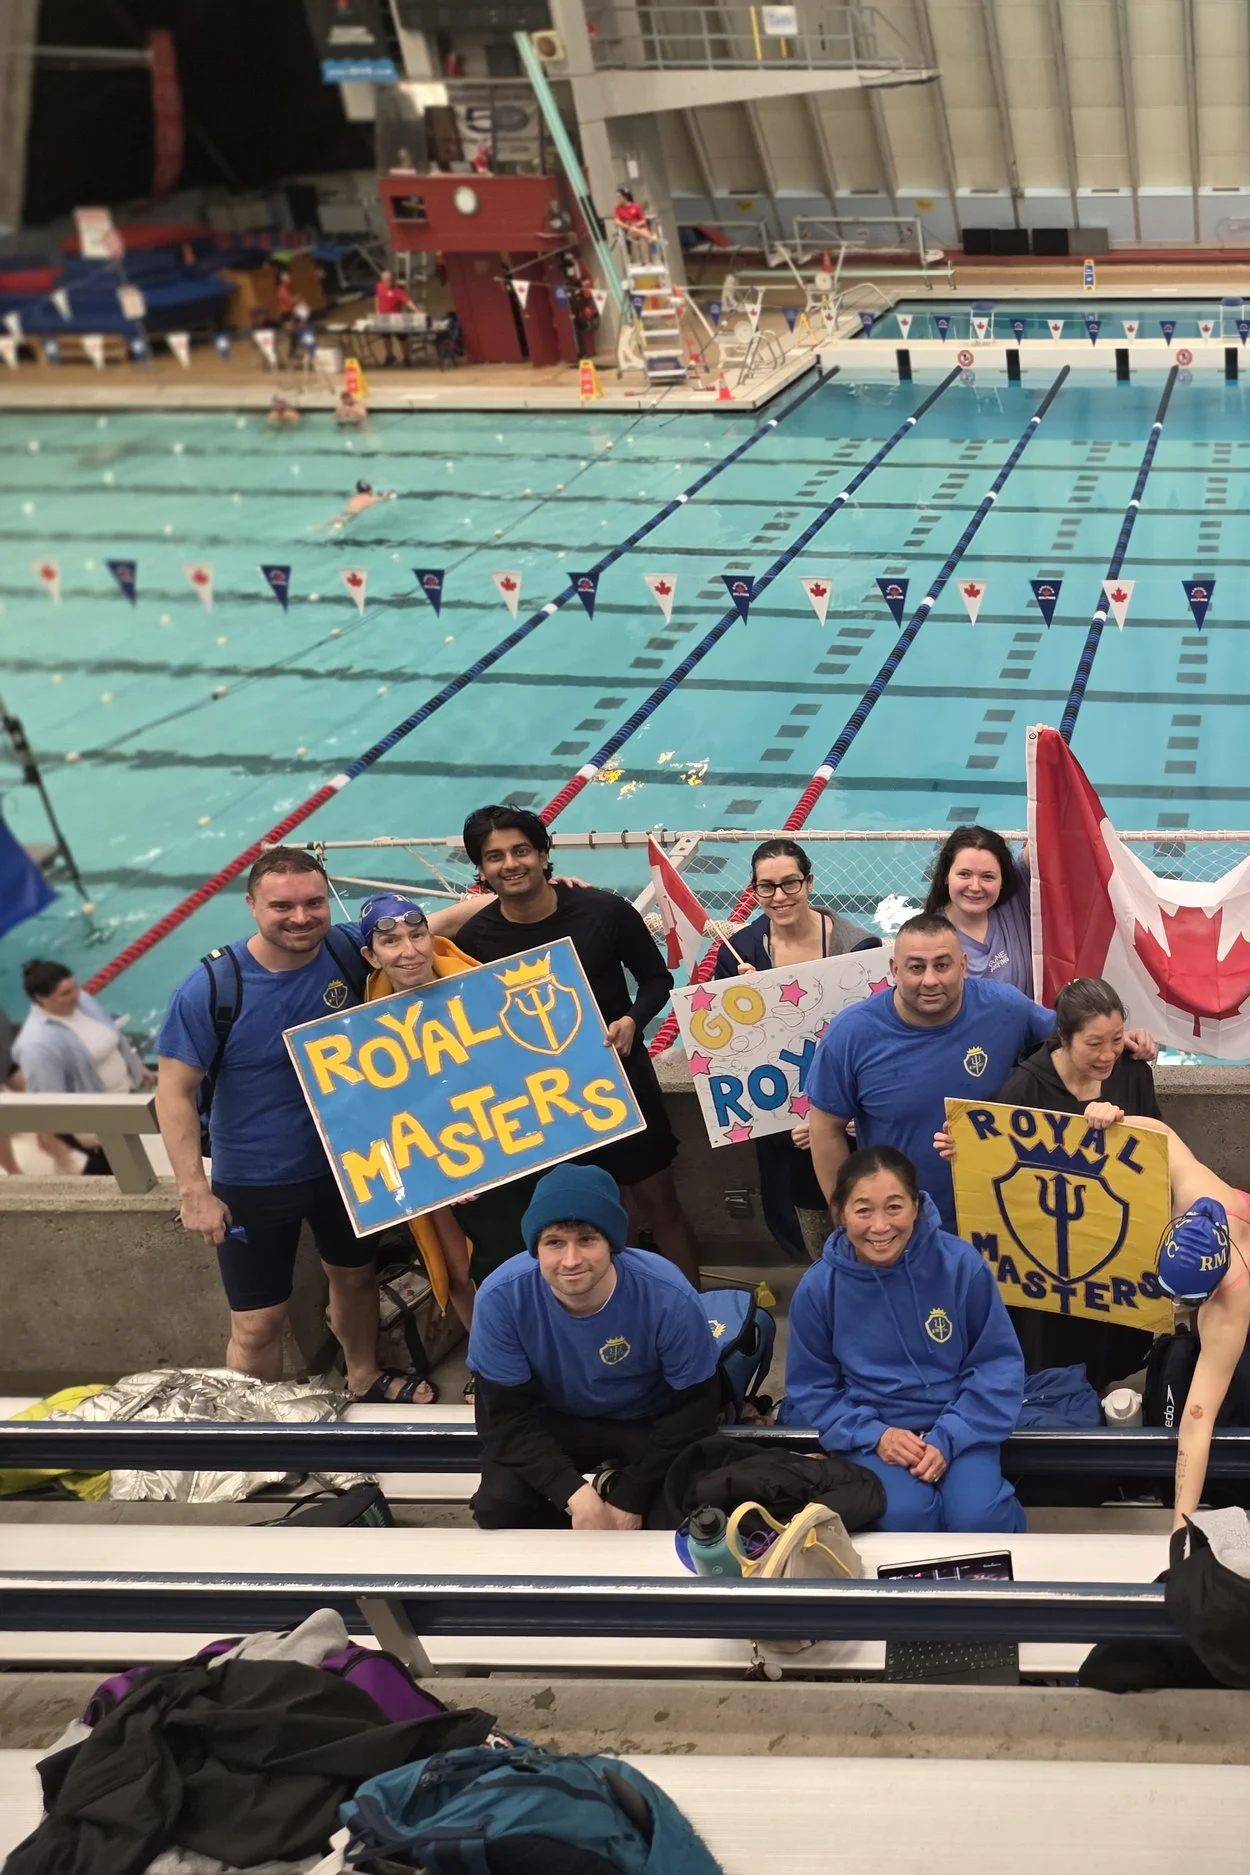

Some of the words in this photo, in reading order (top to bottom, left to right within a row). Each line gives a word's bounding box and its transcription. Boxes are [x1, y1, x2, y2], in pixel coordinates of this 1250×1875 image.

[304, 995, 502, 1095] ROYAL
[689, 984, 767, 1050] GO
[341, 1067, 629, 1204] MASTERS
[967, 1108, 1145, 1175] ROYAL
[971, 1231, 1164, 1315] MASTERS
